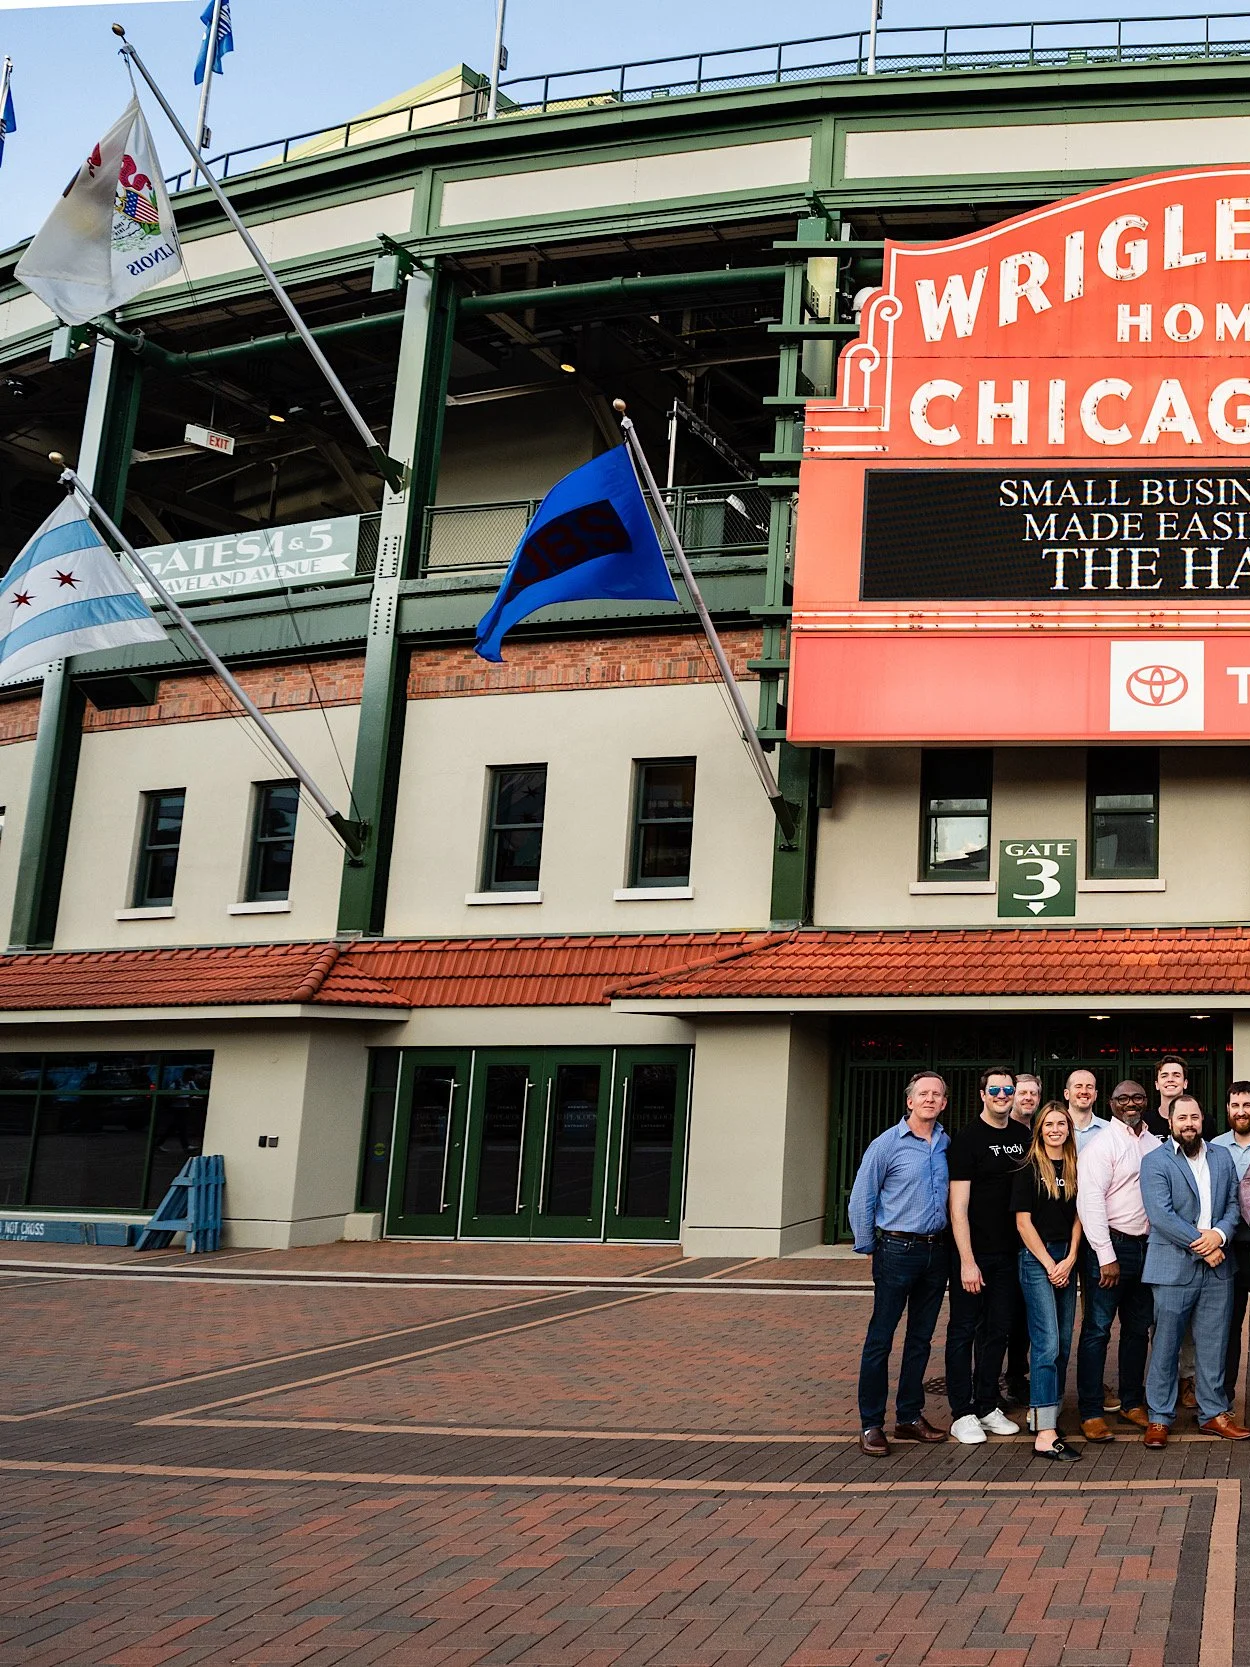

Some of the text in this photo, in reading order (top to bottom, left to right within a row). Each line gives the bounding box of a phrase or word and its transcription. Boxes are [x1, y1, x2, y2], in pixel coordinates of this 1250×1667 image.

[209, 435, 230, 450] EXIT
[999, 479, 1131, 507] SMALL
[1021, 513, 1145, 541] MADE
[505, 509, 626, 603] UBS
[1041, 547, 1163, 590] THE
[164, 558, 321, 593] AVELAND AVENUE
[1005, 843, 1072, 857] GATE
[1012, 858, 1061, 900] 3
[4, 1221, 19, 1235] NOT
[20, 1222, 45, 1236] CROSS
